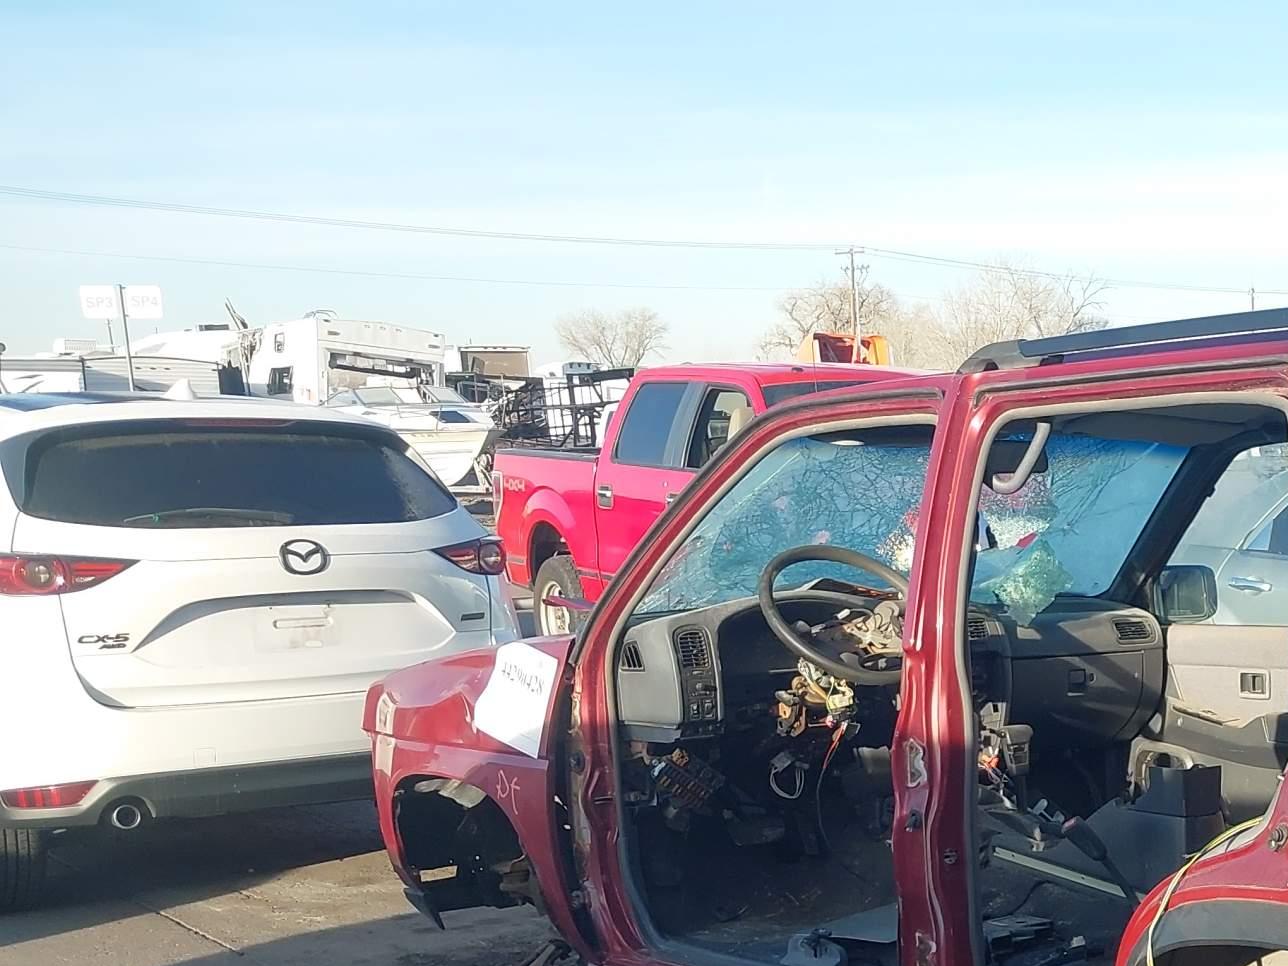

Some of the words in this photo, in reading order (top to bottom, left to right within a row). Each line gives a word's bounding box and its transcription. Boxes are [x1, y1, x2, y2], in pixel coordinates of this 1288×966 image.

[85, 296, 114, 309] SP3
[130, 295, 160, 307] SP4
[77, 633, 130, 644] CX-5
